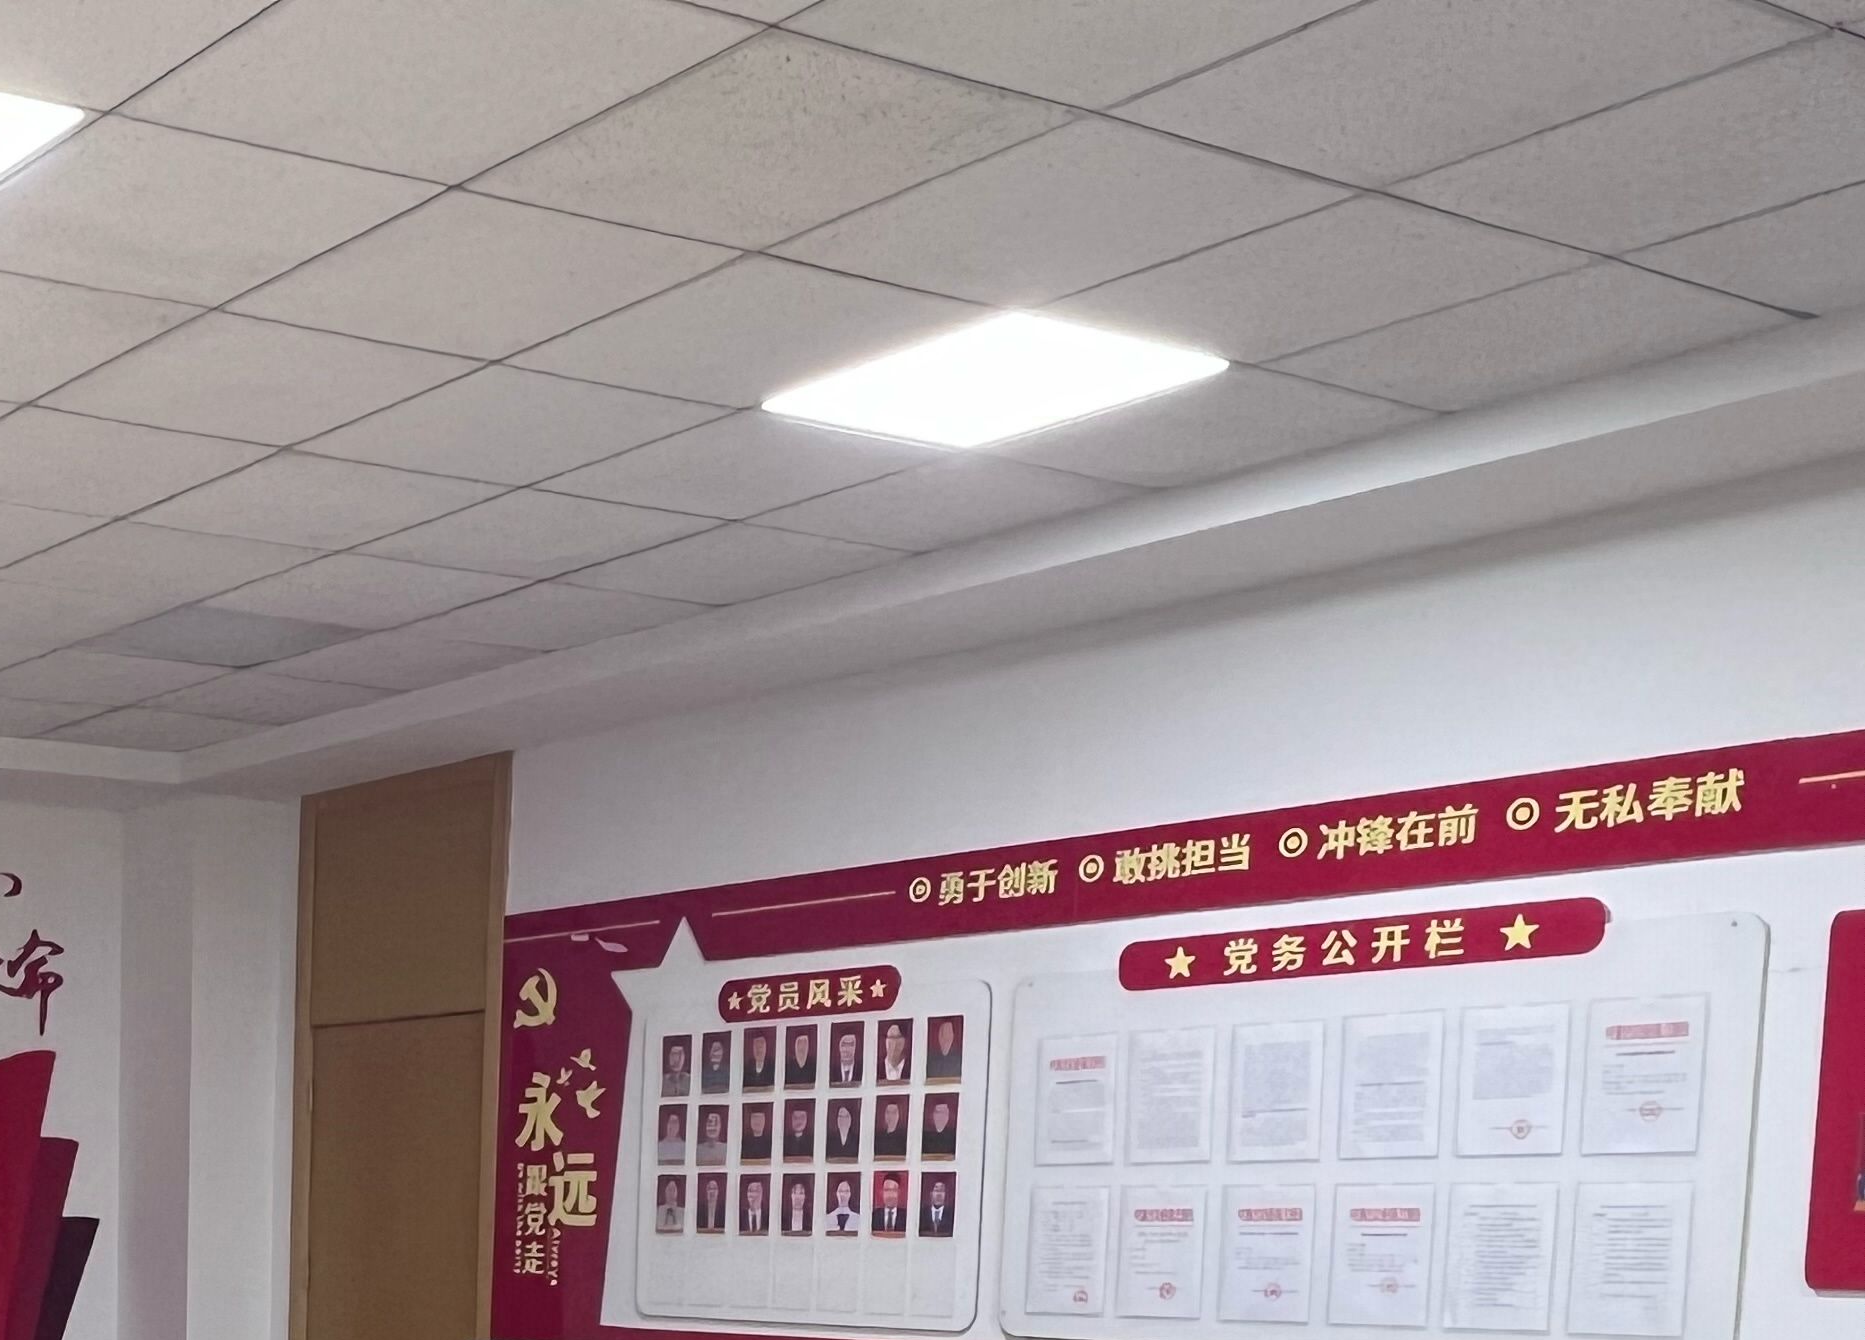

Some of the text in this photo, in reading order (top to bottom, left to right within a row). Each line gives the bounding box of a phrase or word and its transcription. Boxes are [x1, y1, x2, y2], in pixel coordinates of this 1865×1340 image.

[938, 768, 1746, 906] 勇于创新 敢挑担当 冲锋在前 无私奉献
[1223, 917, 1465, 977] 党务公开栏
[747, 975, 864, 1014] 党员风采
